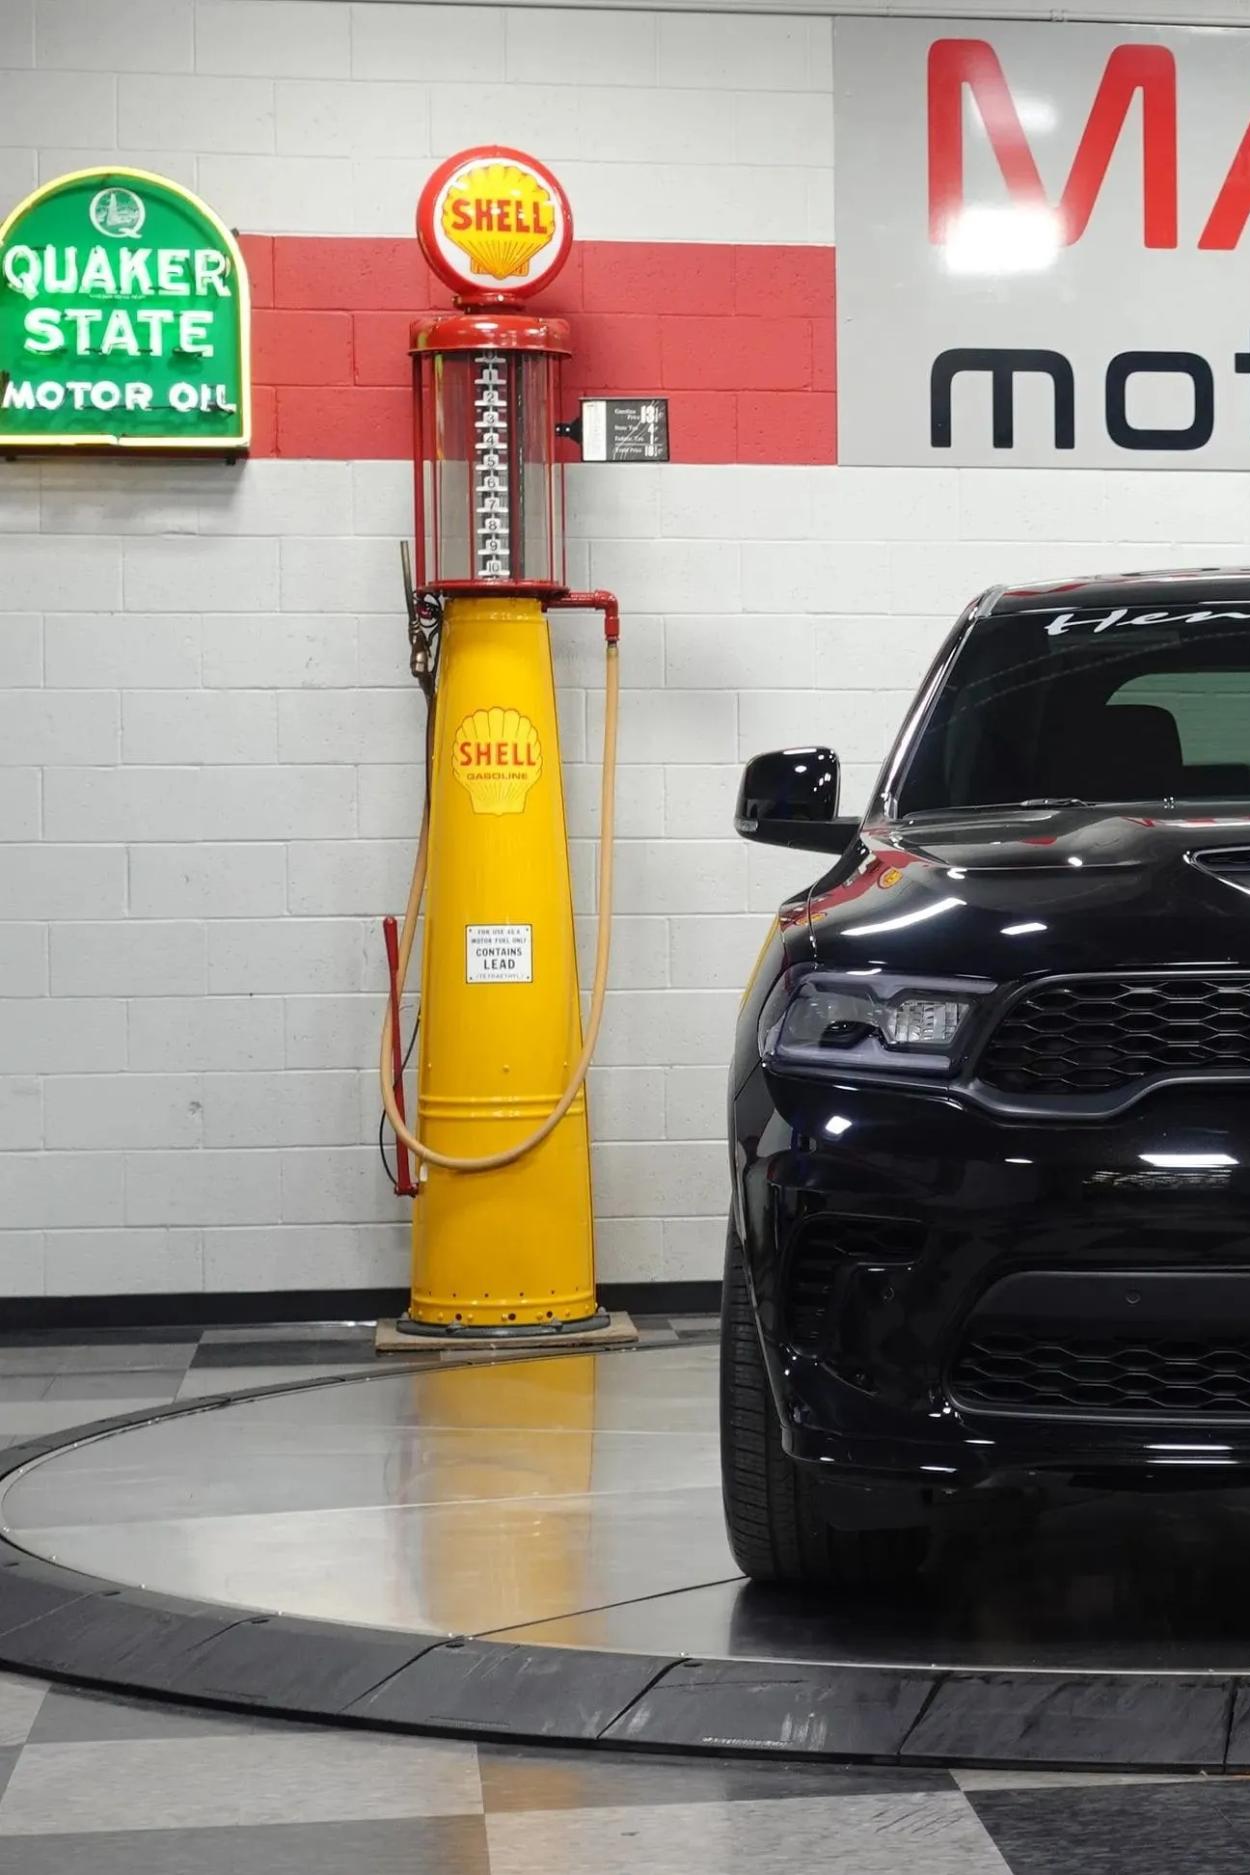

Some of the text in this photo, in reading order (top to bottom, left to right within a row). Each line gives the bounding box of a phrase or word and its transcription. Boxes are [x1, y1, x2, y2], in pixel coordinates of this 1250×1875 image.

[451, 198, 547, 234] SHELL
[3, 244, 232, 300] QUAKER
[23, 307, 214, 358] STATE
[1, 381, 237, 412] MOTOR OIL
[487, 477, 496, 488] 6
[488, 499, 496, 510] 7
[488, 520, 497, 531] 8
[489, 541, 498, 551] 9
[488, 562, 500, 572] 10
[459, 741, 537, 767] SHELL
[466, 772, 528, 780] GASOLINE
[475, 947, 522, 957] CONTAINS
[483, 958, 516, 970] LEAD
